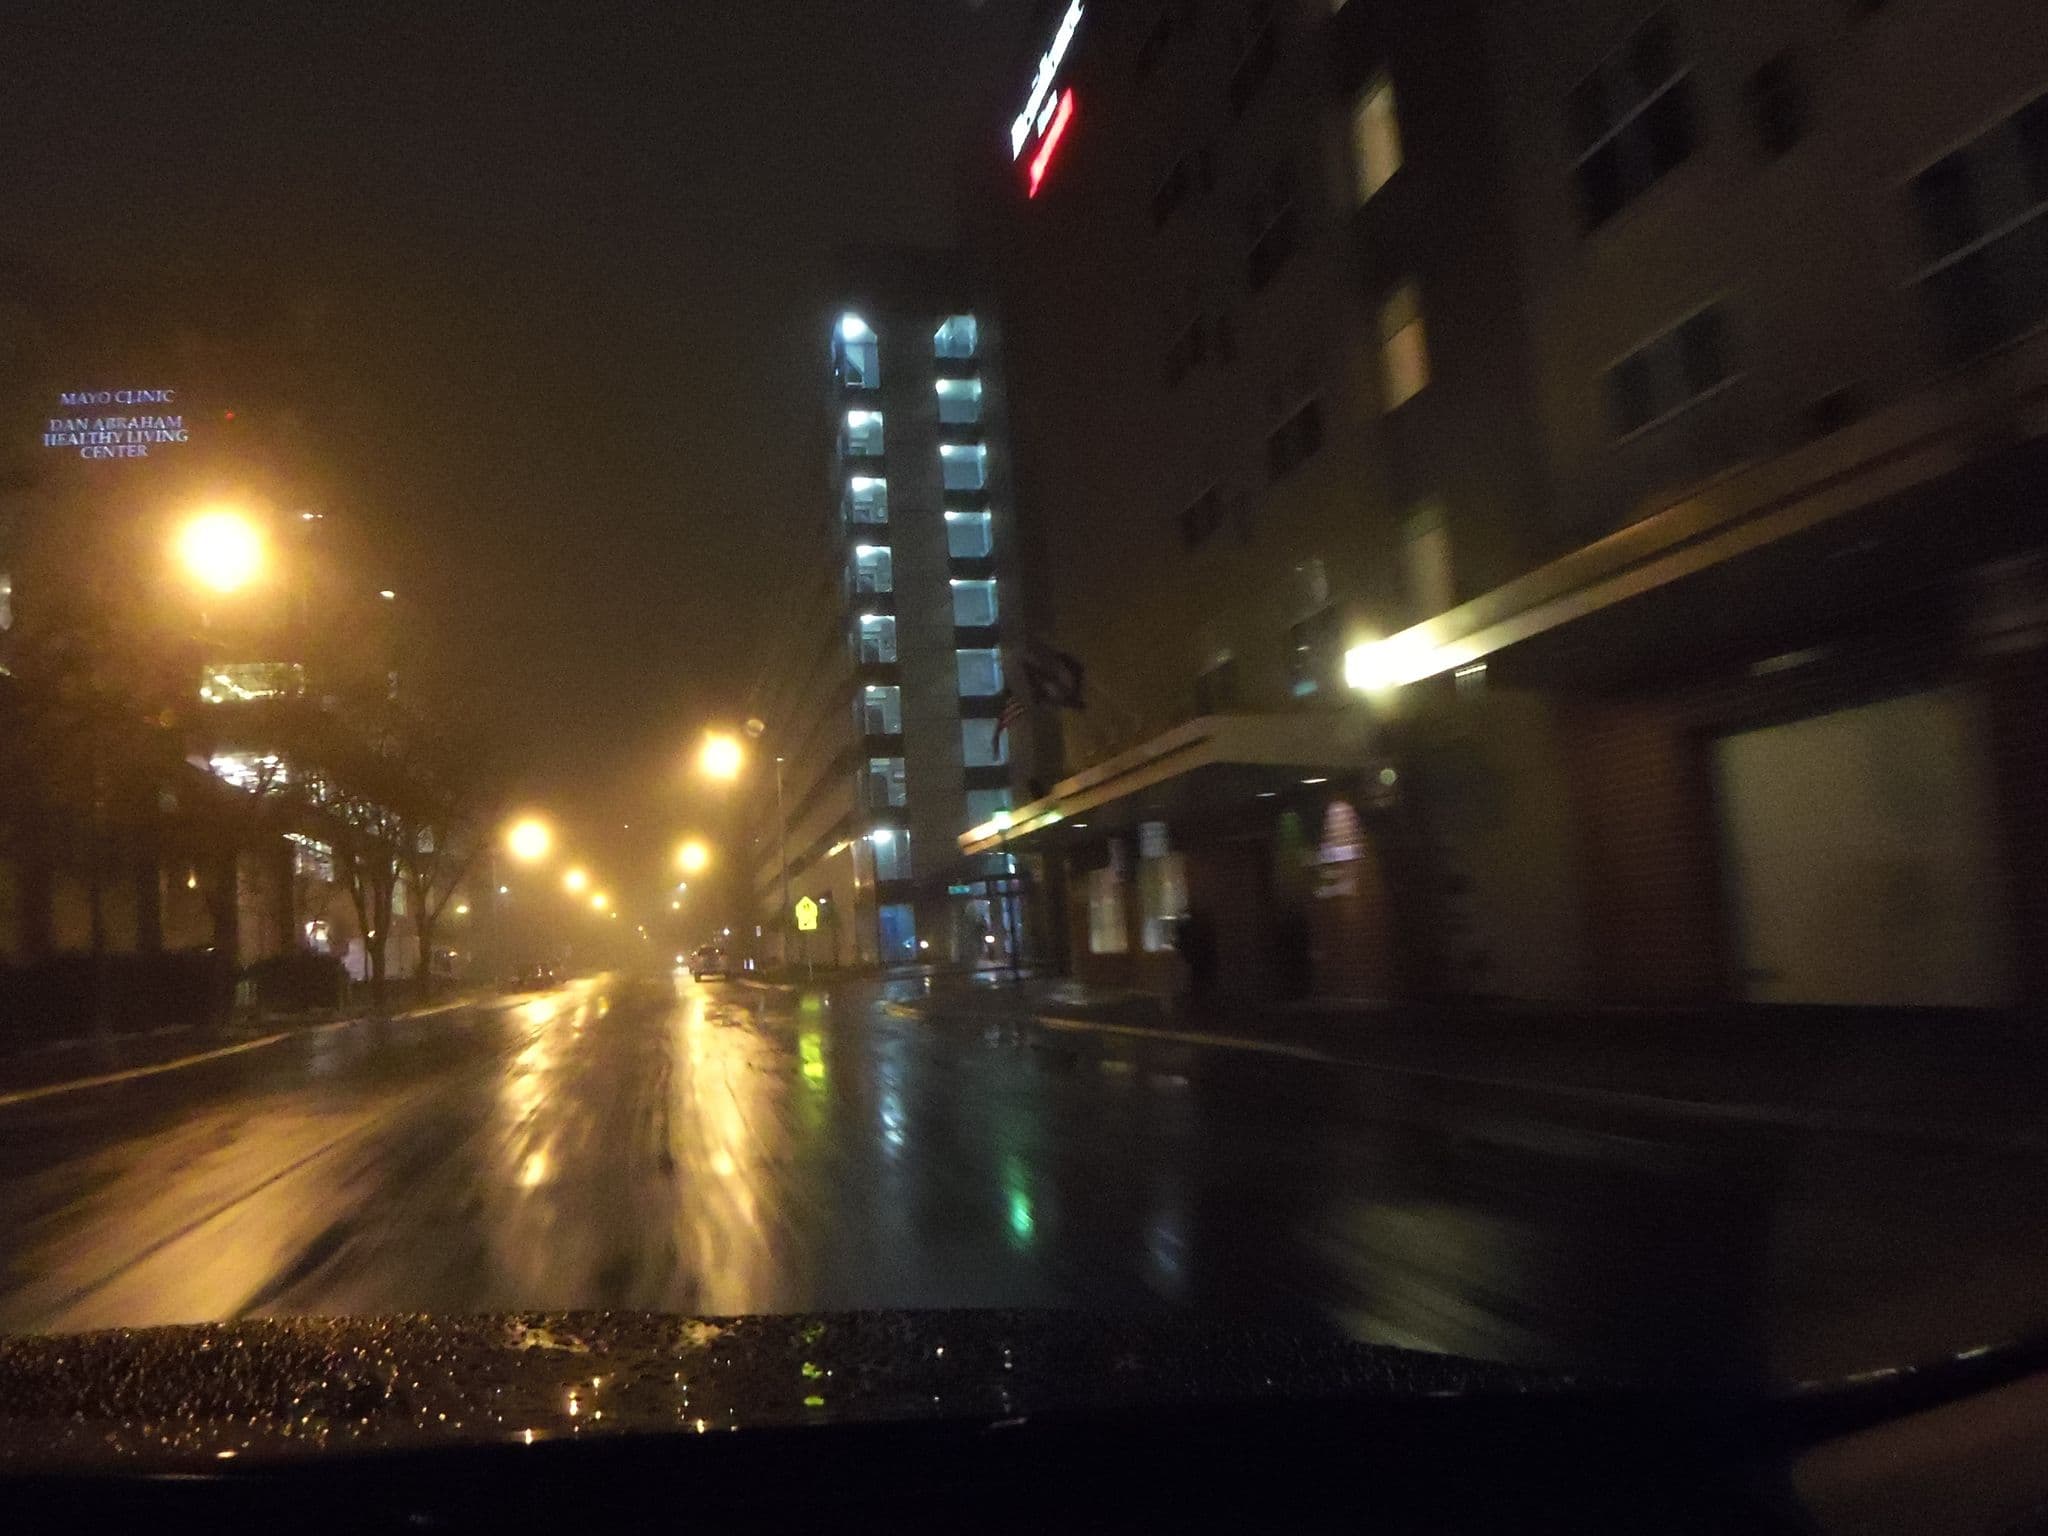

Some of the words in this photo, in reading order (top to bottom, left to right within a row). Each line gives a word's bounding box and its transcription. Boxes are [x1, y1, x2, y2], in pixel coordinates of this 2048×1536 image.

[61, 392, 111, 404] MAYO
[114, 390, 175, 404] CLINIC
[50, 418, 89, 431] DAN
[94, 416, 182, 430] ABRAHAM
[44, 431, 122, 446] HEALTHY
[127, 430, 188, 443] LIVING
[80, 445, 148, 458] CENTER
